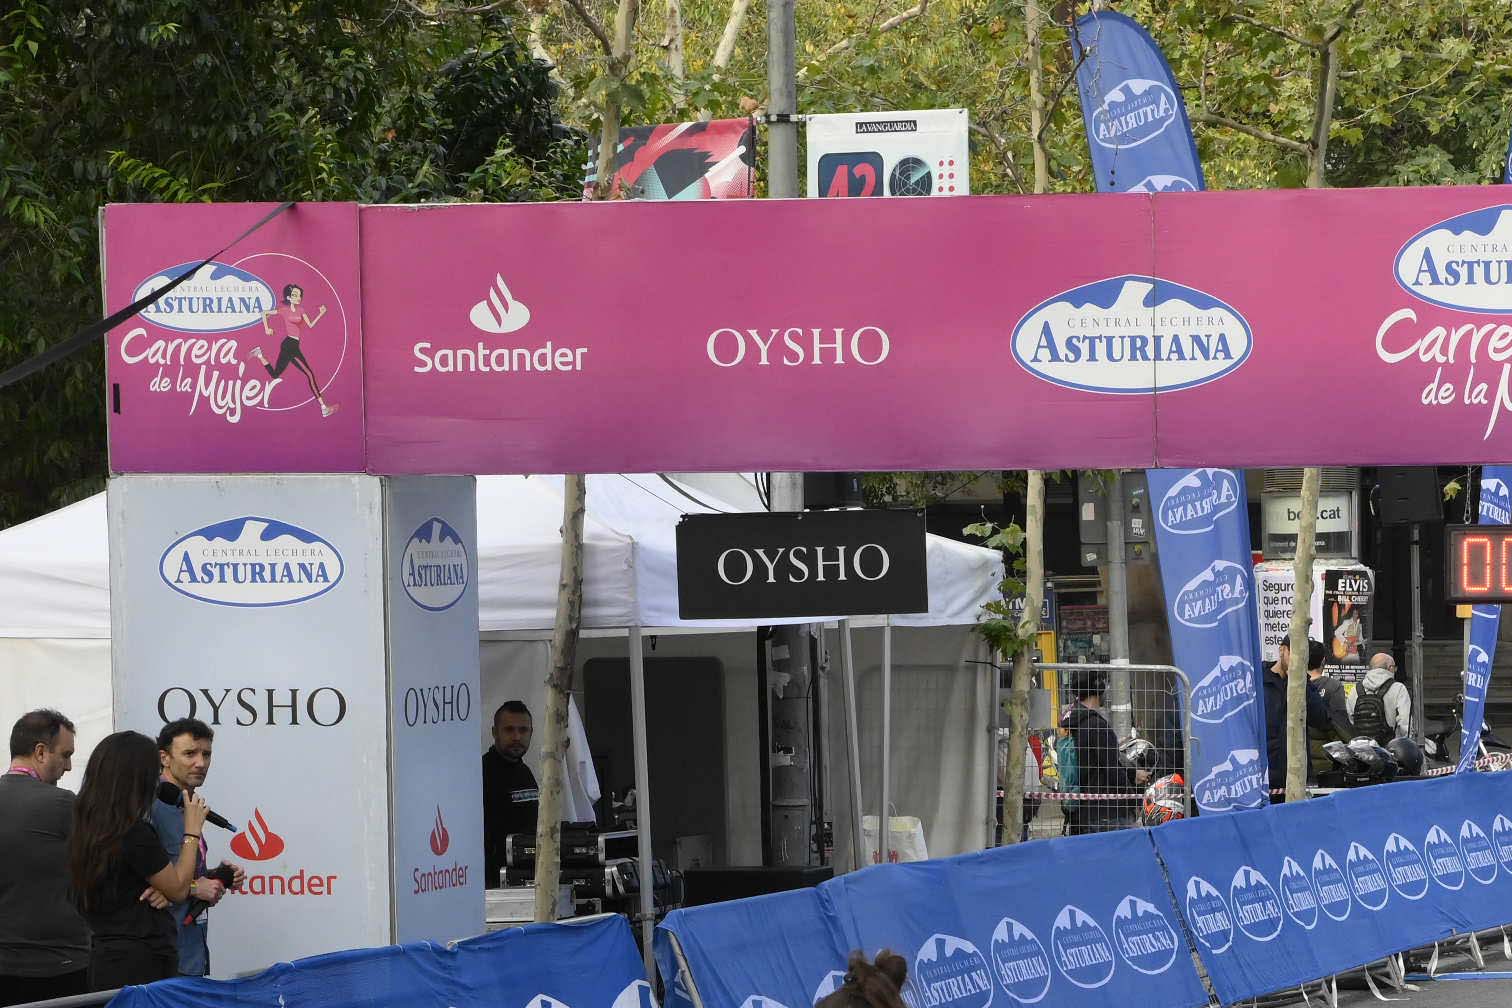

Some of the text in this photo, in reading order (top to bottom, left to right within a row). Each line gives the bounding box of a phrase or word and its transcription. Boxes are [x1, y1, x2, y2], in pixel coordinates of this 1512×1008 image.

[867, 121, 915, 131] VANGUARDIA
[146, 288, 263, 313] ASTURIANA
[1067, 315, 1225, 329] CENTRAL LECHERA
[121, 328, 238, 364] Carrera
[413, 341, 588, 373] Santander
[707, 326, 890, 367] OYSHO
[1030, 320, 1234, 363] ASTURIANA
[150, 361, 282, 423] de la Mujer
[1421, 367, 1455, 406] de
[1464, 365, 1488, 405] la
[174, 550, 330, 584] ASTURIANA
[202, 548, 324, 557] CENTRAL LECHERA
[717, 543, 890, 585] OYSHO
[407, 553, 464, 587] ASTURIANA
[1338, 578, 1368, 591] ELVIS
[1263, 596, 1279, 606] que
[1264, 607, 1295, 619] quiere
[157, 687, 347, 727] OYSHO
[404, 682, 471, 727] OYSHO
[231, 869, 337, 895] tander
[413, 863, 468, 895] Santander
[997, 954, 1048, 985] ASTURIANA
[1057, 940, 1112, 971] ASTURIANA
[920, 967, 990, 1007] ASTURIANA
